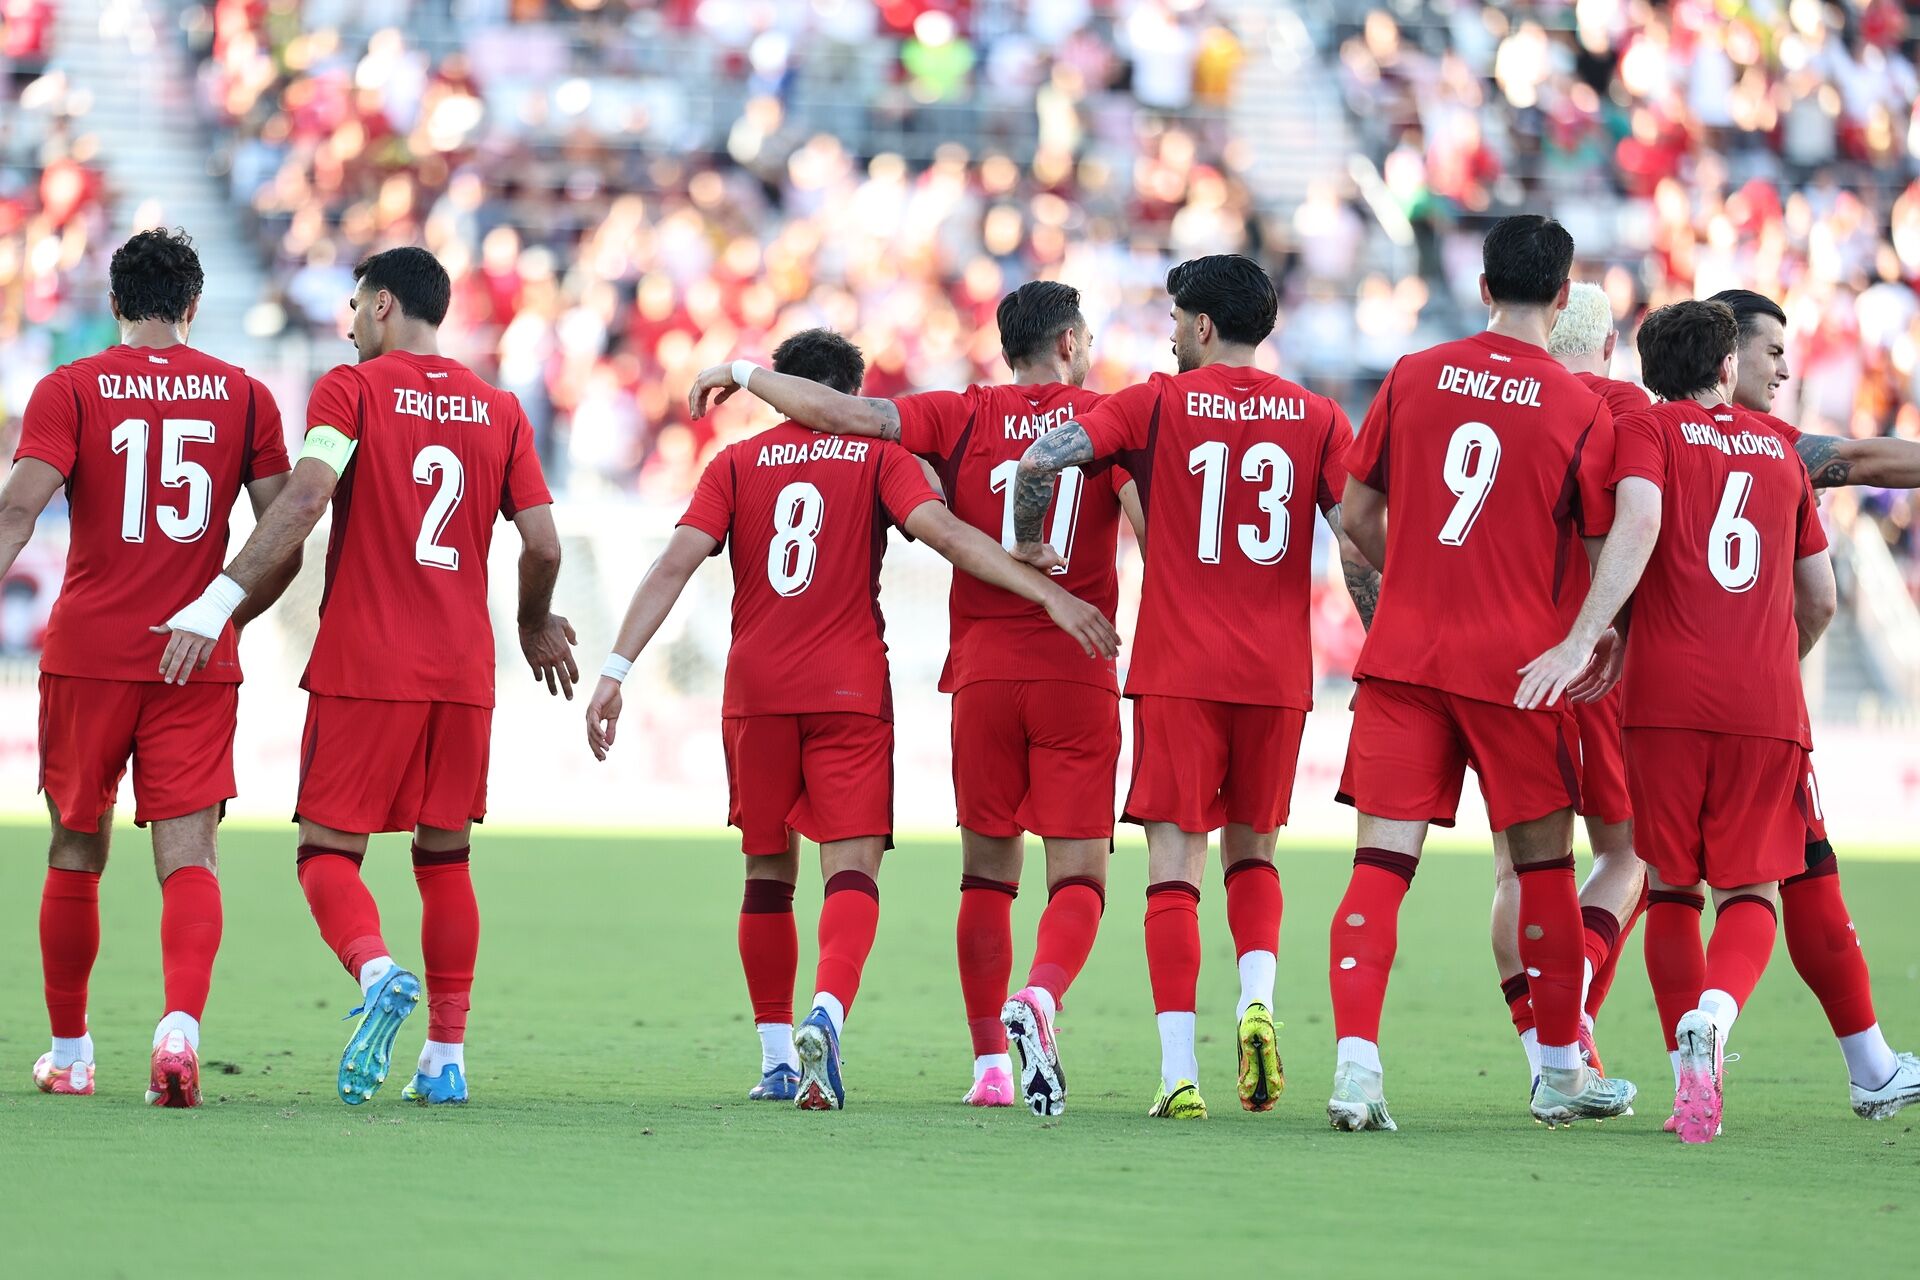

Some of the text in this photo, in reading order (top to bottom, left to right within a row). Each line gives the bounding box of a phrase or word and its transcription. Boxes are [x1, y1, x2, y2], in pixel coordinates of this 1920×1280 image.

[98, 374, 230, 401] OZAN KABAK
[393, 388, 491, 427] ZEKİ ÇELİK
[1187, 391, 1305, 421] EREN ELMALI
[1437, 365, 1542, 408] DENİZ GÜL
[111, 418, 216, 544] 15
[412, 444, 465, 571] 2
[756, 435, 869, 467] ARDA GÜLER
[1188, 440, 1295, 566] 13
[1438, 421, 1502, 546] 9
[767, 481, 825, 598] 8
[1708, 471, 1761, 594] 6
